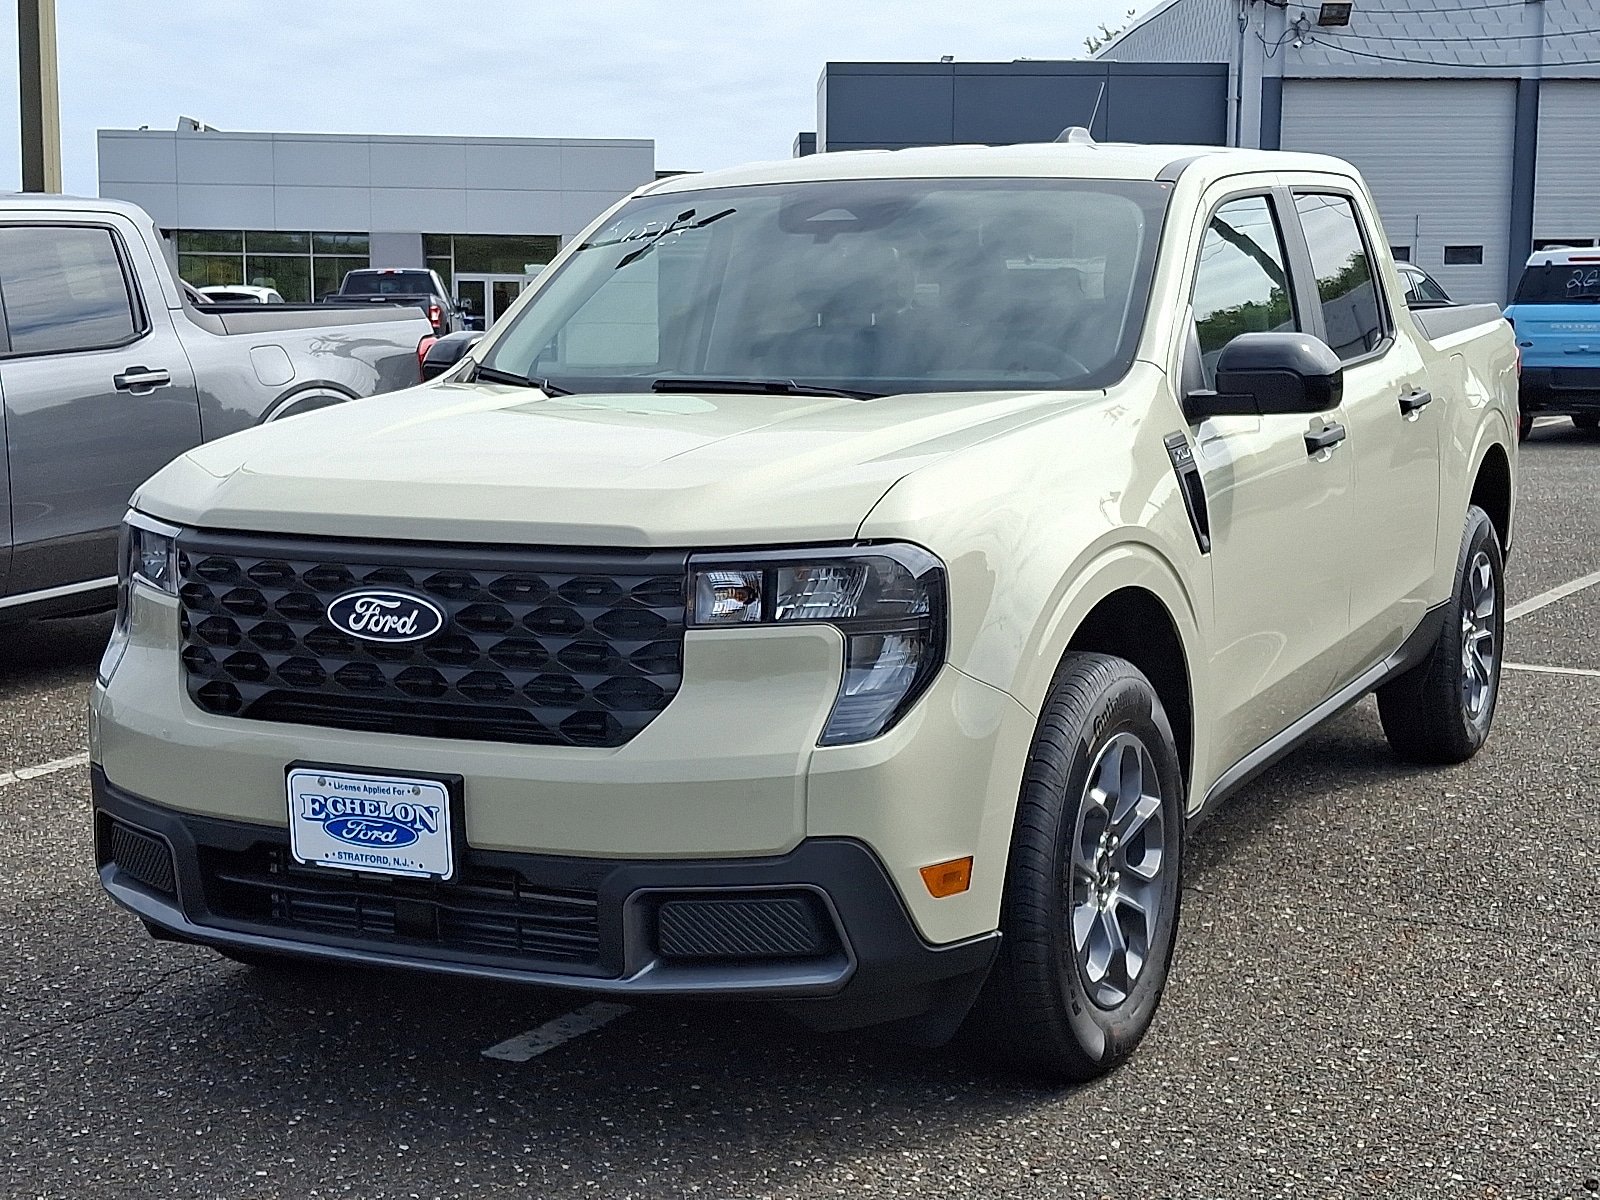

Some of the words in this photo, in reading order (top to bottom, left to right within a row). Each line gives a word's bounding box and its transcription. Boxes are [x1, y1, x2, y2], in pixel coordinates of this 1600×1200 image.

[348, 597, 419, 635] Ford
[333, 782, 361, 793] License
[363, 785, 391, 795] Applied
[393, 787, 405, 795] For
[300, 794, 440, 834] ECHELON
[342, 819, 398, 843] Ford
[337, 851, 391, 867] STRATFORD,
[393, 858, 410, 868] N.J.
